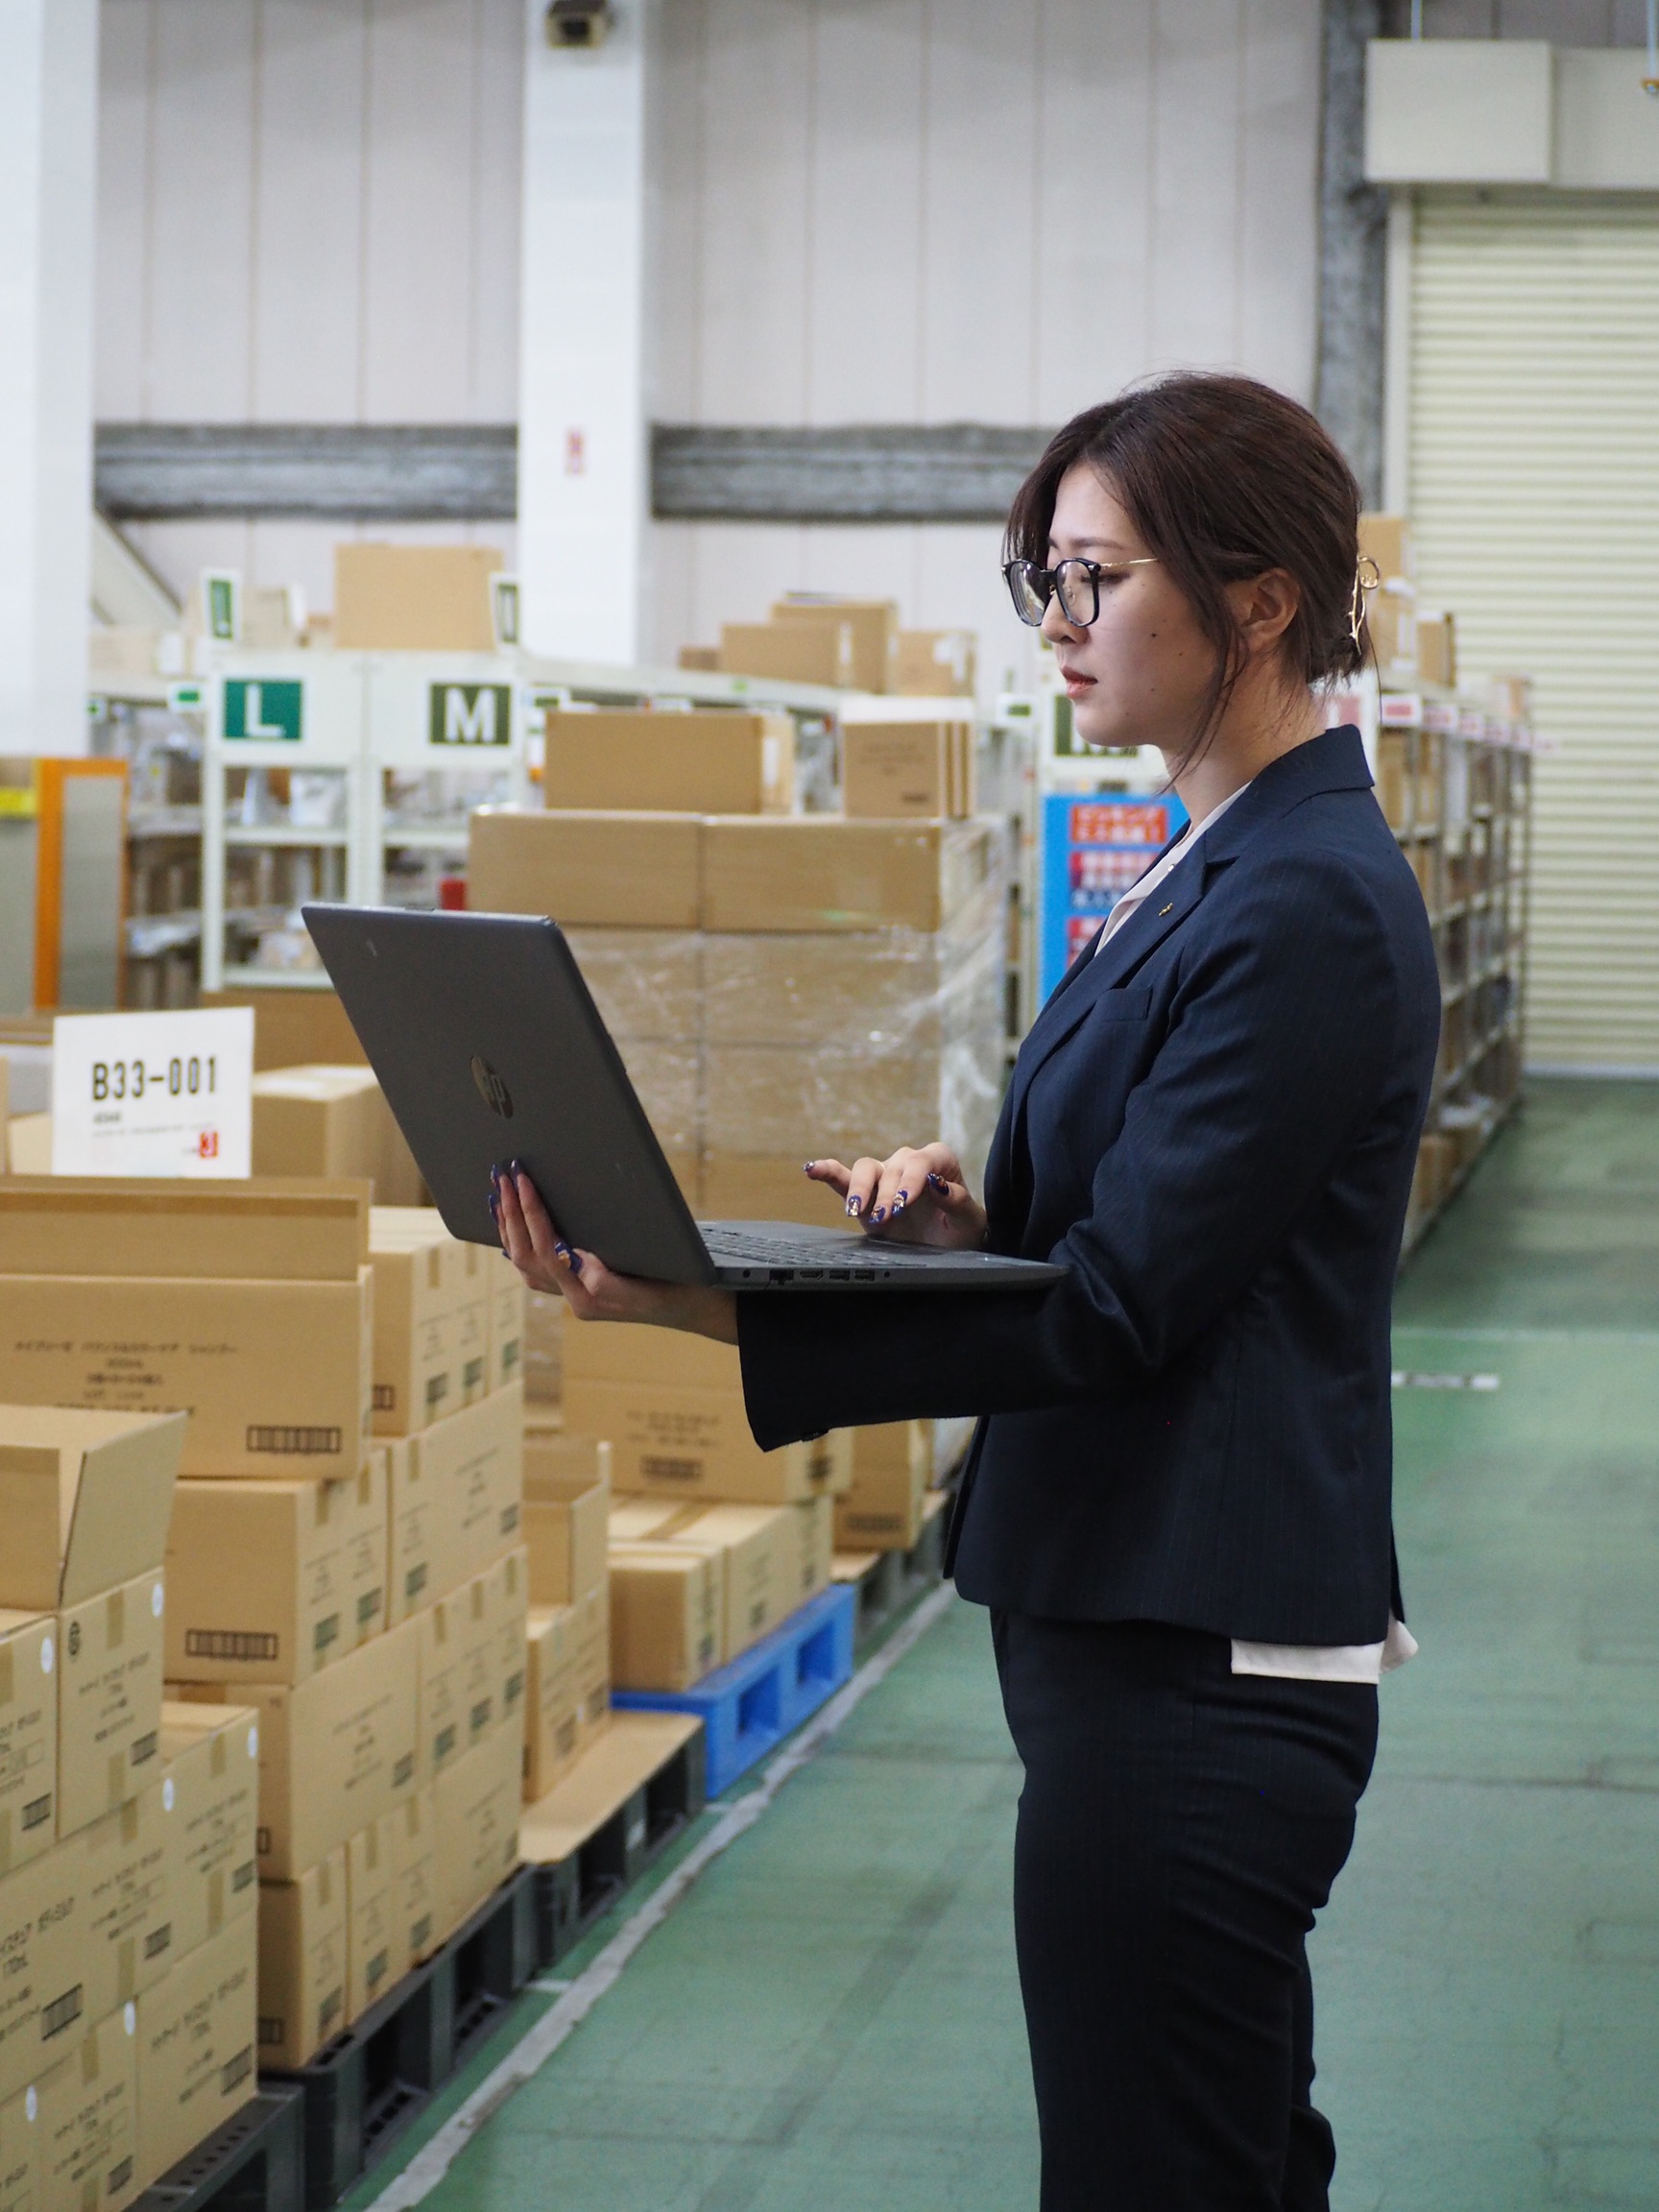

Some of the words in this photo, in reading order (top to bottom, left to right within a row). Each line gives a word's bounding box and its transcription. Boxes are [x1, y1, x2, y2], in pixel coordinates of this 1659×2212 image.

[245, 683, 284, 737] L
[445, 686, 495, 742] M
[93, 1057, 216, 1100] B33-001
